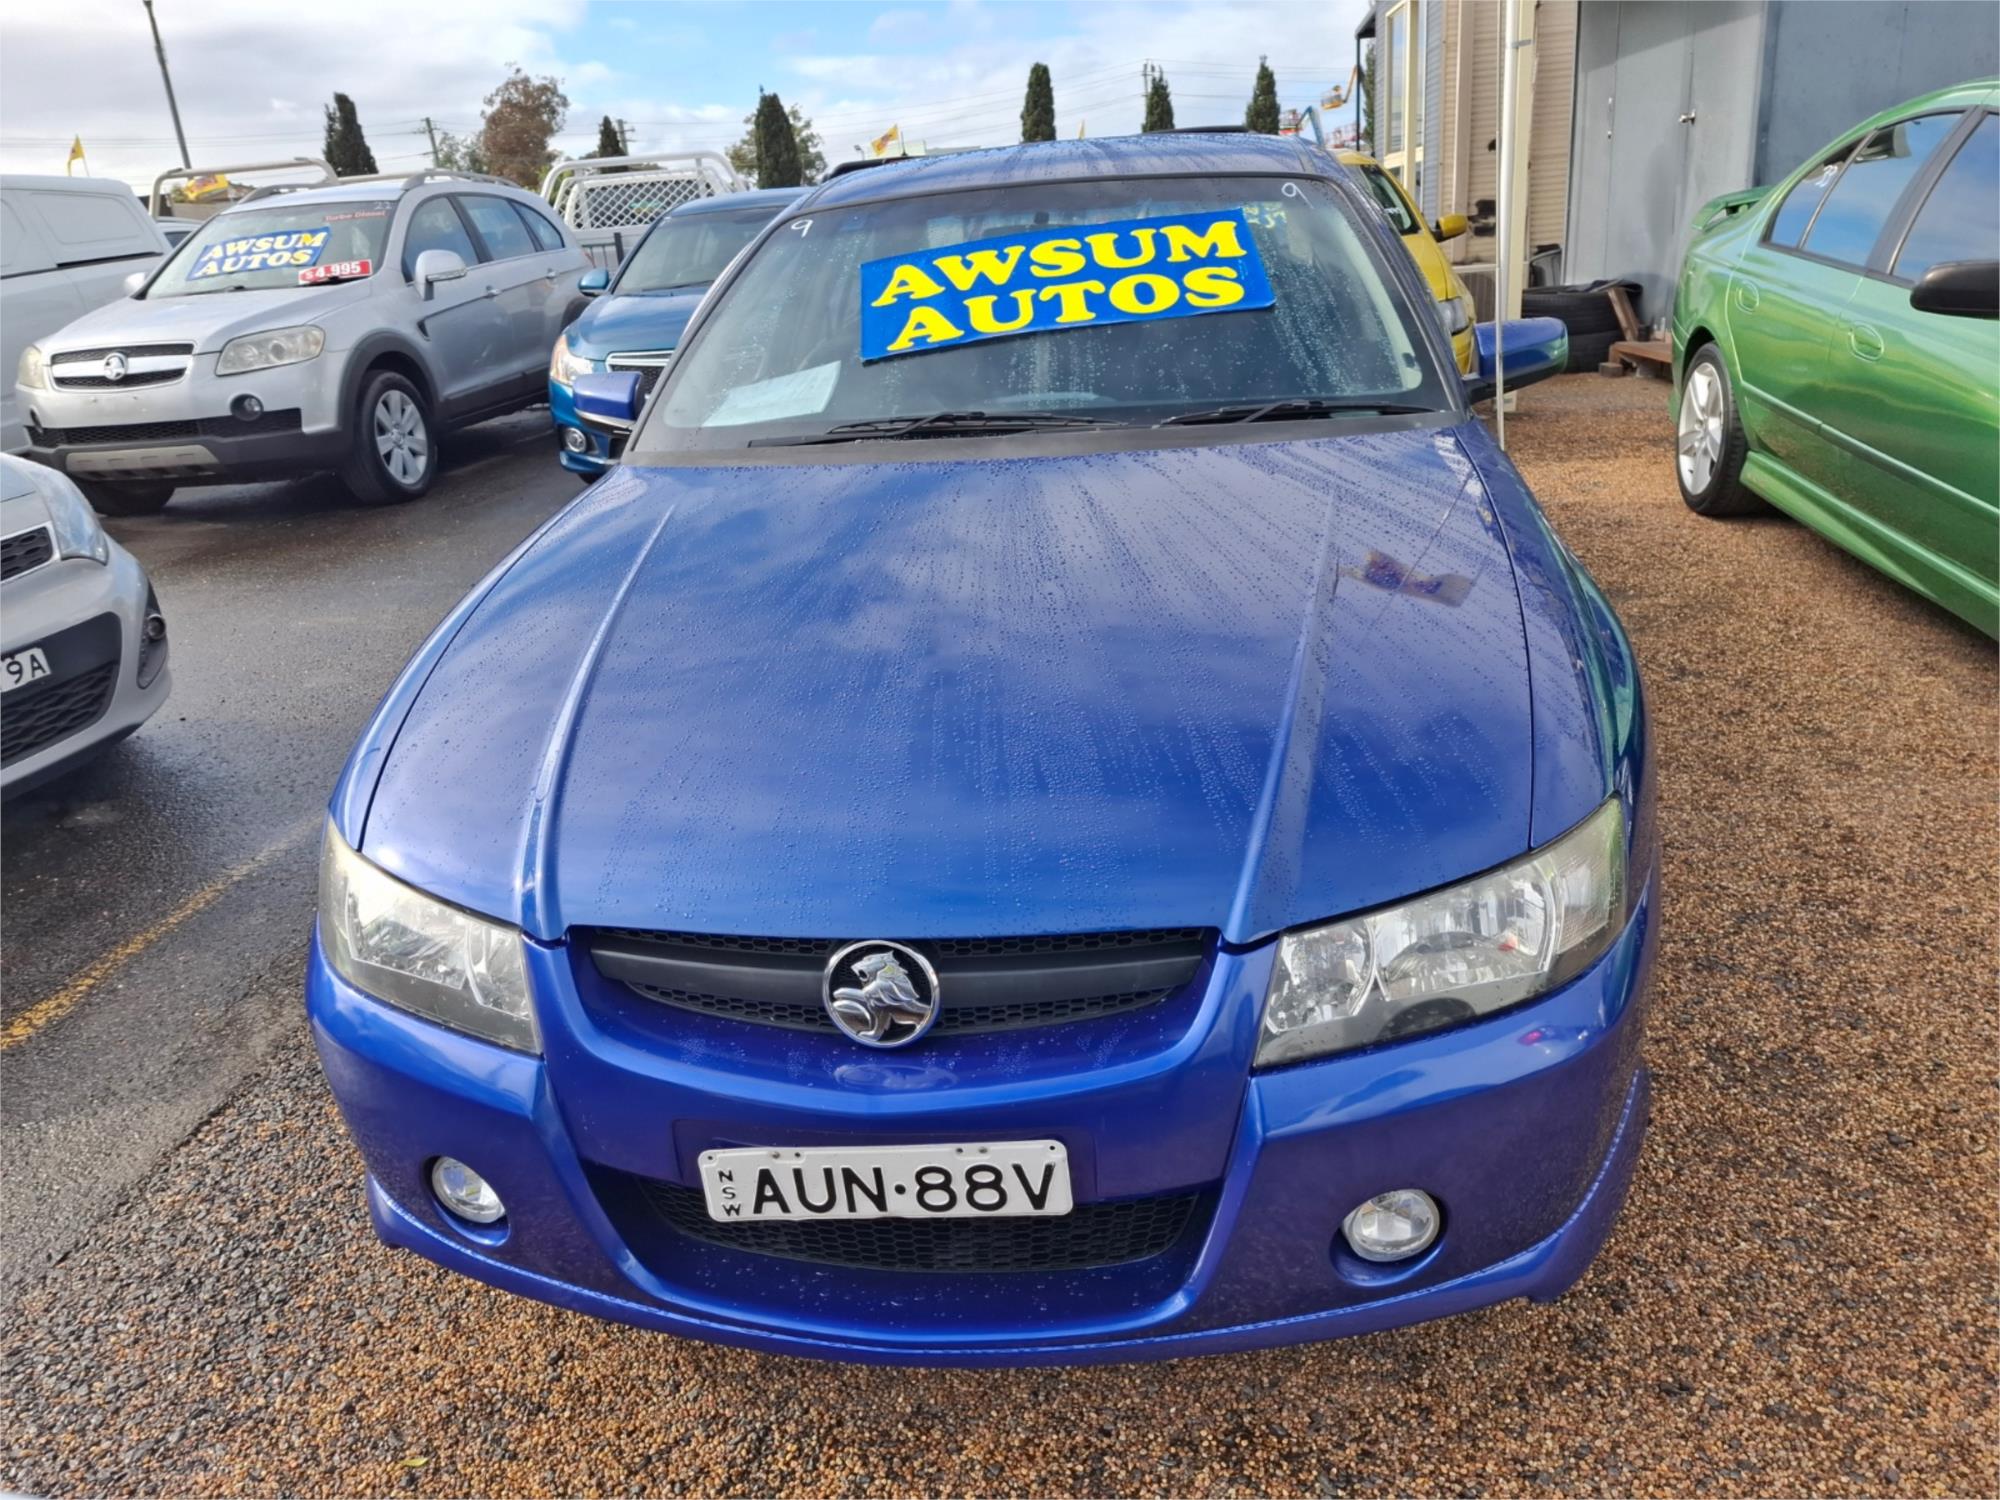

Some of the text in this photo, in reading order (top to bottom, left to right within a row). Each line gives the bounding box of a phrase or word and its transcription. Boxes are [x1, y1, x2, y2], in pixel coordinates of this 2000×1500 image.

[1281, 182, 1317, 210] 9
[791, 219, 814, 239] 9
[200, 231, 328, 261] AWSUM
[194, 249, 313, 277] AUTOS
[871, 220, 1247, 307] AWSUM
[886, 266, 1245, 352] AUTOS
[717, 1169, 742, 1217] NSW
